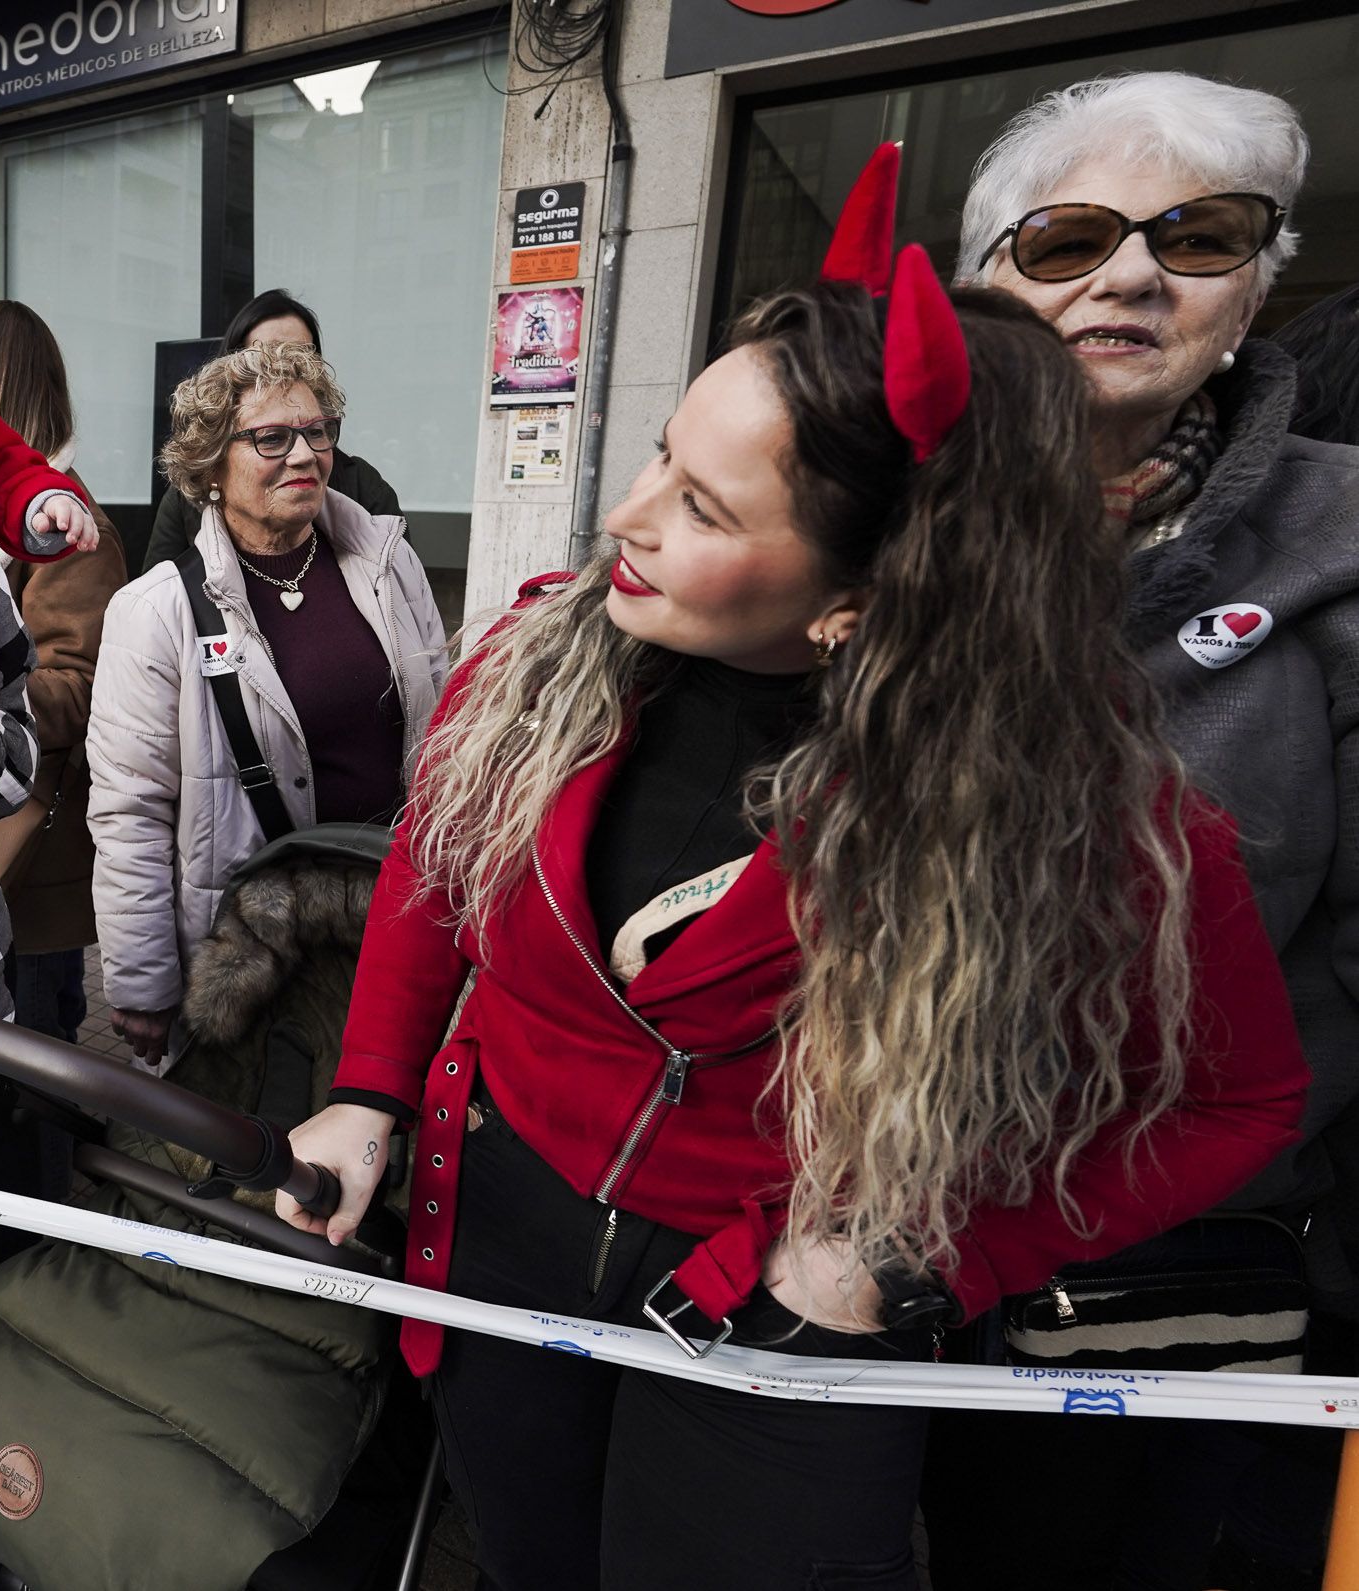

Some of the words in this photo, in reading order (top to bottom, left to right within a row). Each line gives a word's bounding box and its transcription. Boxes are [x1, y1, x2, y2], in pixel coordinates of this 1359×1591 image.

[46, 54, 116, 84] MÉDICOS
[121, 47, 143, 65] DE
[148, 26, 224, 56] BELLEZA
[518, 207, 579, 223] segurma
[519, 234, 535, 244] 914
[538, 232, 554, 243] 188
[557, 230, 574, 240] 188
[1195, 614, 1219, 637] I
[1184, 637, 1223, 647] VAMOS
[1225, 639, 1232, 648] A
[202, 643, 213, 659] I
